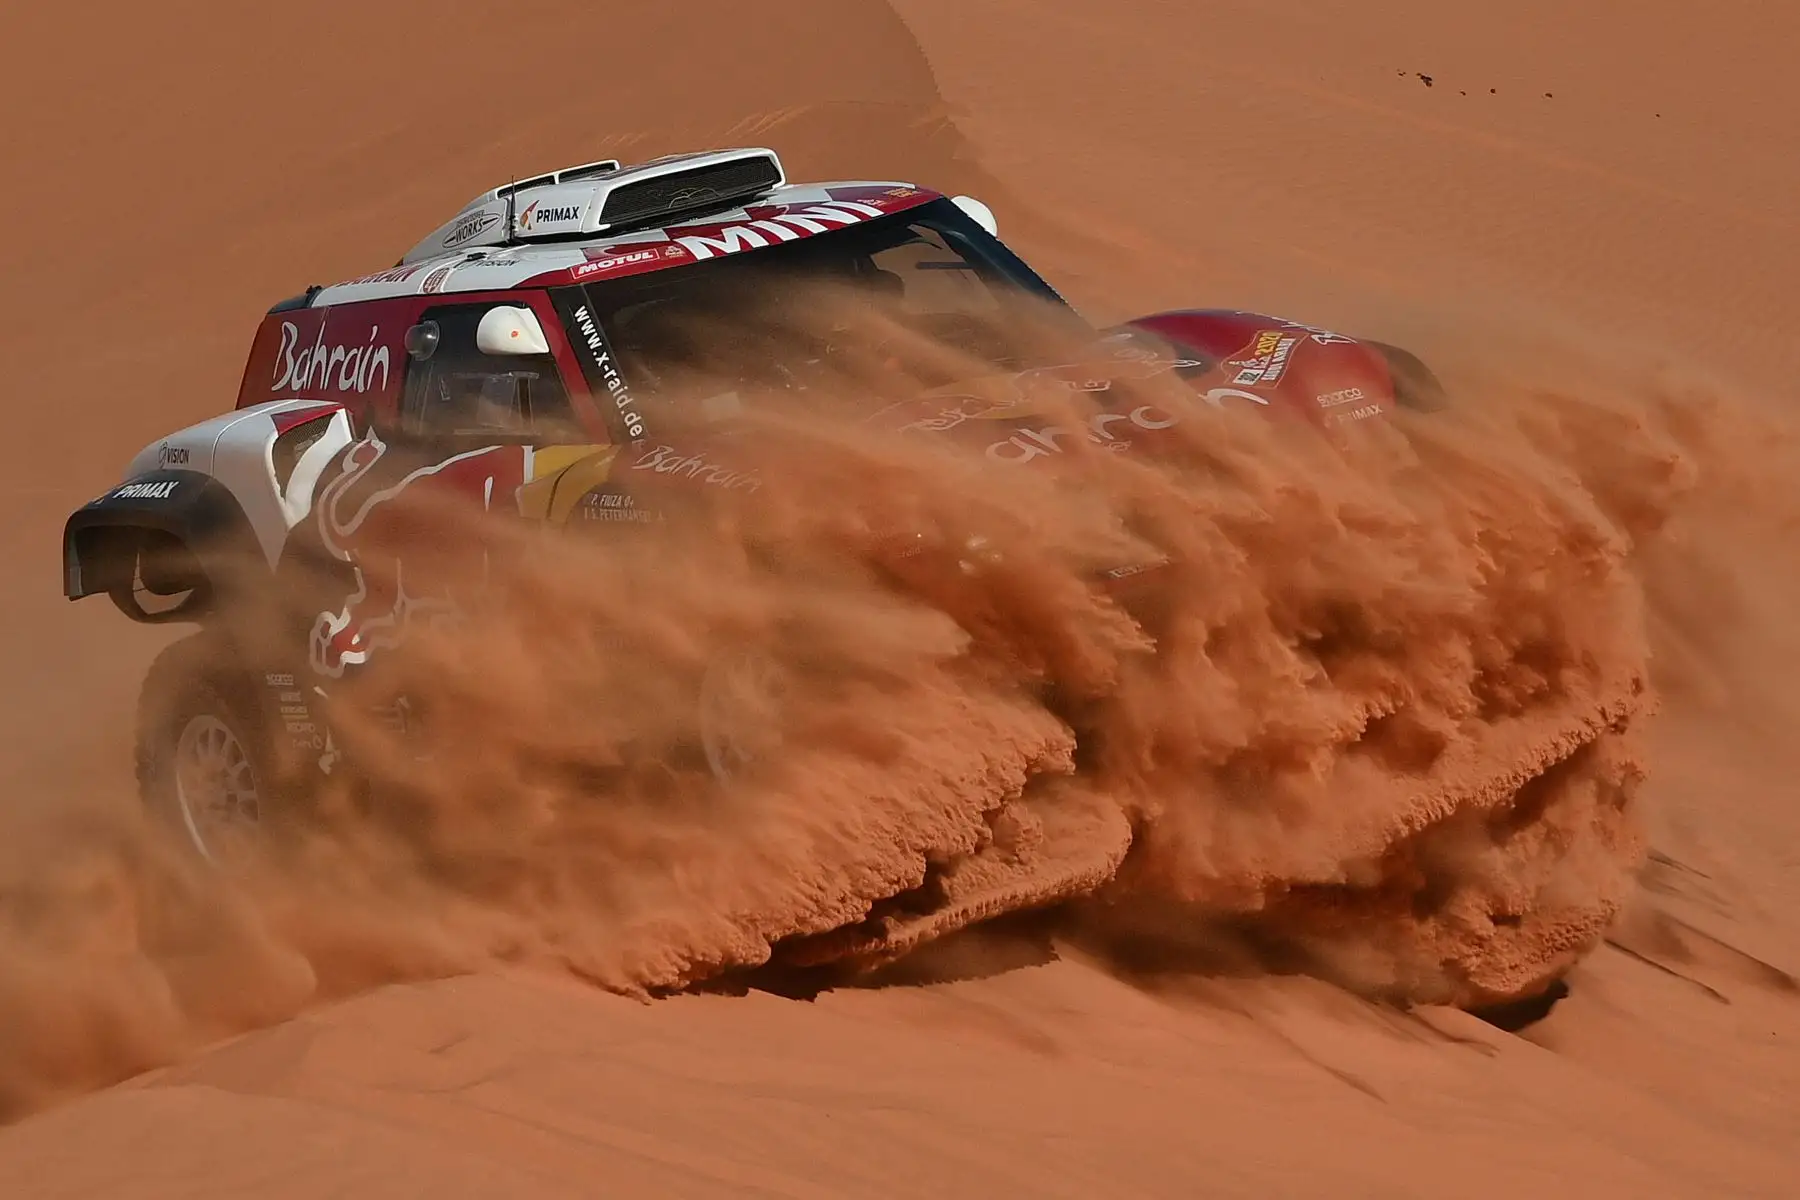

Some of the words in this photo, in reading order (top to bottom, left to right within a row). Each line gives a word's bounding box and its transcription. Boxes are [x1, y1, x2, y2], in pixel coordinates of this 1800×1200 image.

[536, 205, 580, 224] PRIMAX
[455, 218, 484, 243] WORKS
[672, 200, 885, 261] MINI
[577, 251, 654, 275] MOTUL
[271, 320, 390, 392] Bahrain
[574, 305, 643, 437] www.x-raid.de
[1316, 387, 1364, 407] sparco
[166, 448, 190, 464] VISION
[112, 481, 180, 499] PRIMAX
[599, 494, 622, 508] FIUZA
